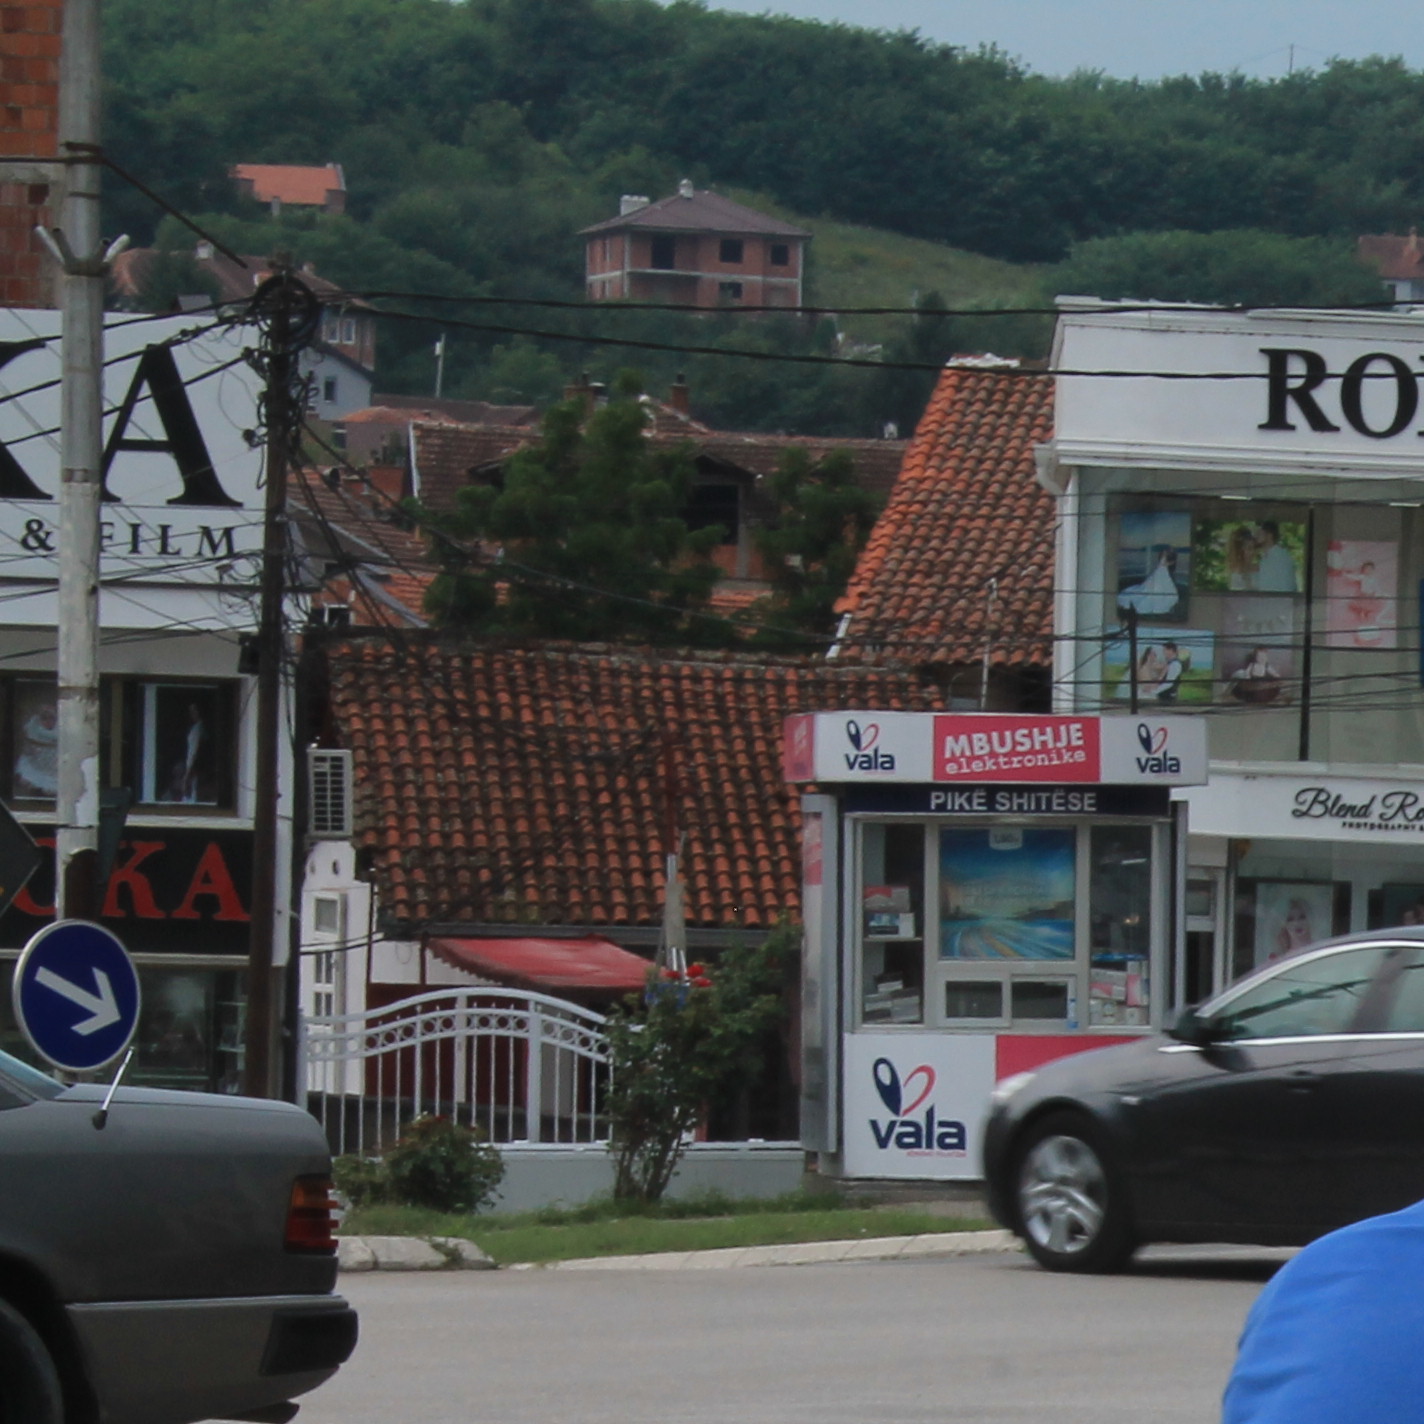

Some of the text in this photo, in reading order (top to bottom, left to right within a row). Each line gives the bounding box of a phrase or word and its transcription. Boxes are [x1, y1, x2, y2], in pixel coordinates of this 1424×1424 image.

[20, 518, 56, 552] &
[943, 722, 1085, 759] MBUSHJE
[844, 745, 896, 772] vala
[945, 748, 1087, 776] elektronike
[1136, 748, 1182, 774] vala
[930, 789, 1097, 812] PIKË SHITËSE
[1291, 787, 1377, 819] Blend
[868, 1103, 967, 1151] vala
